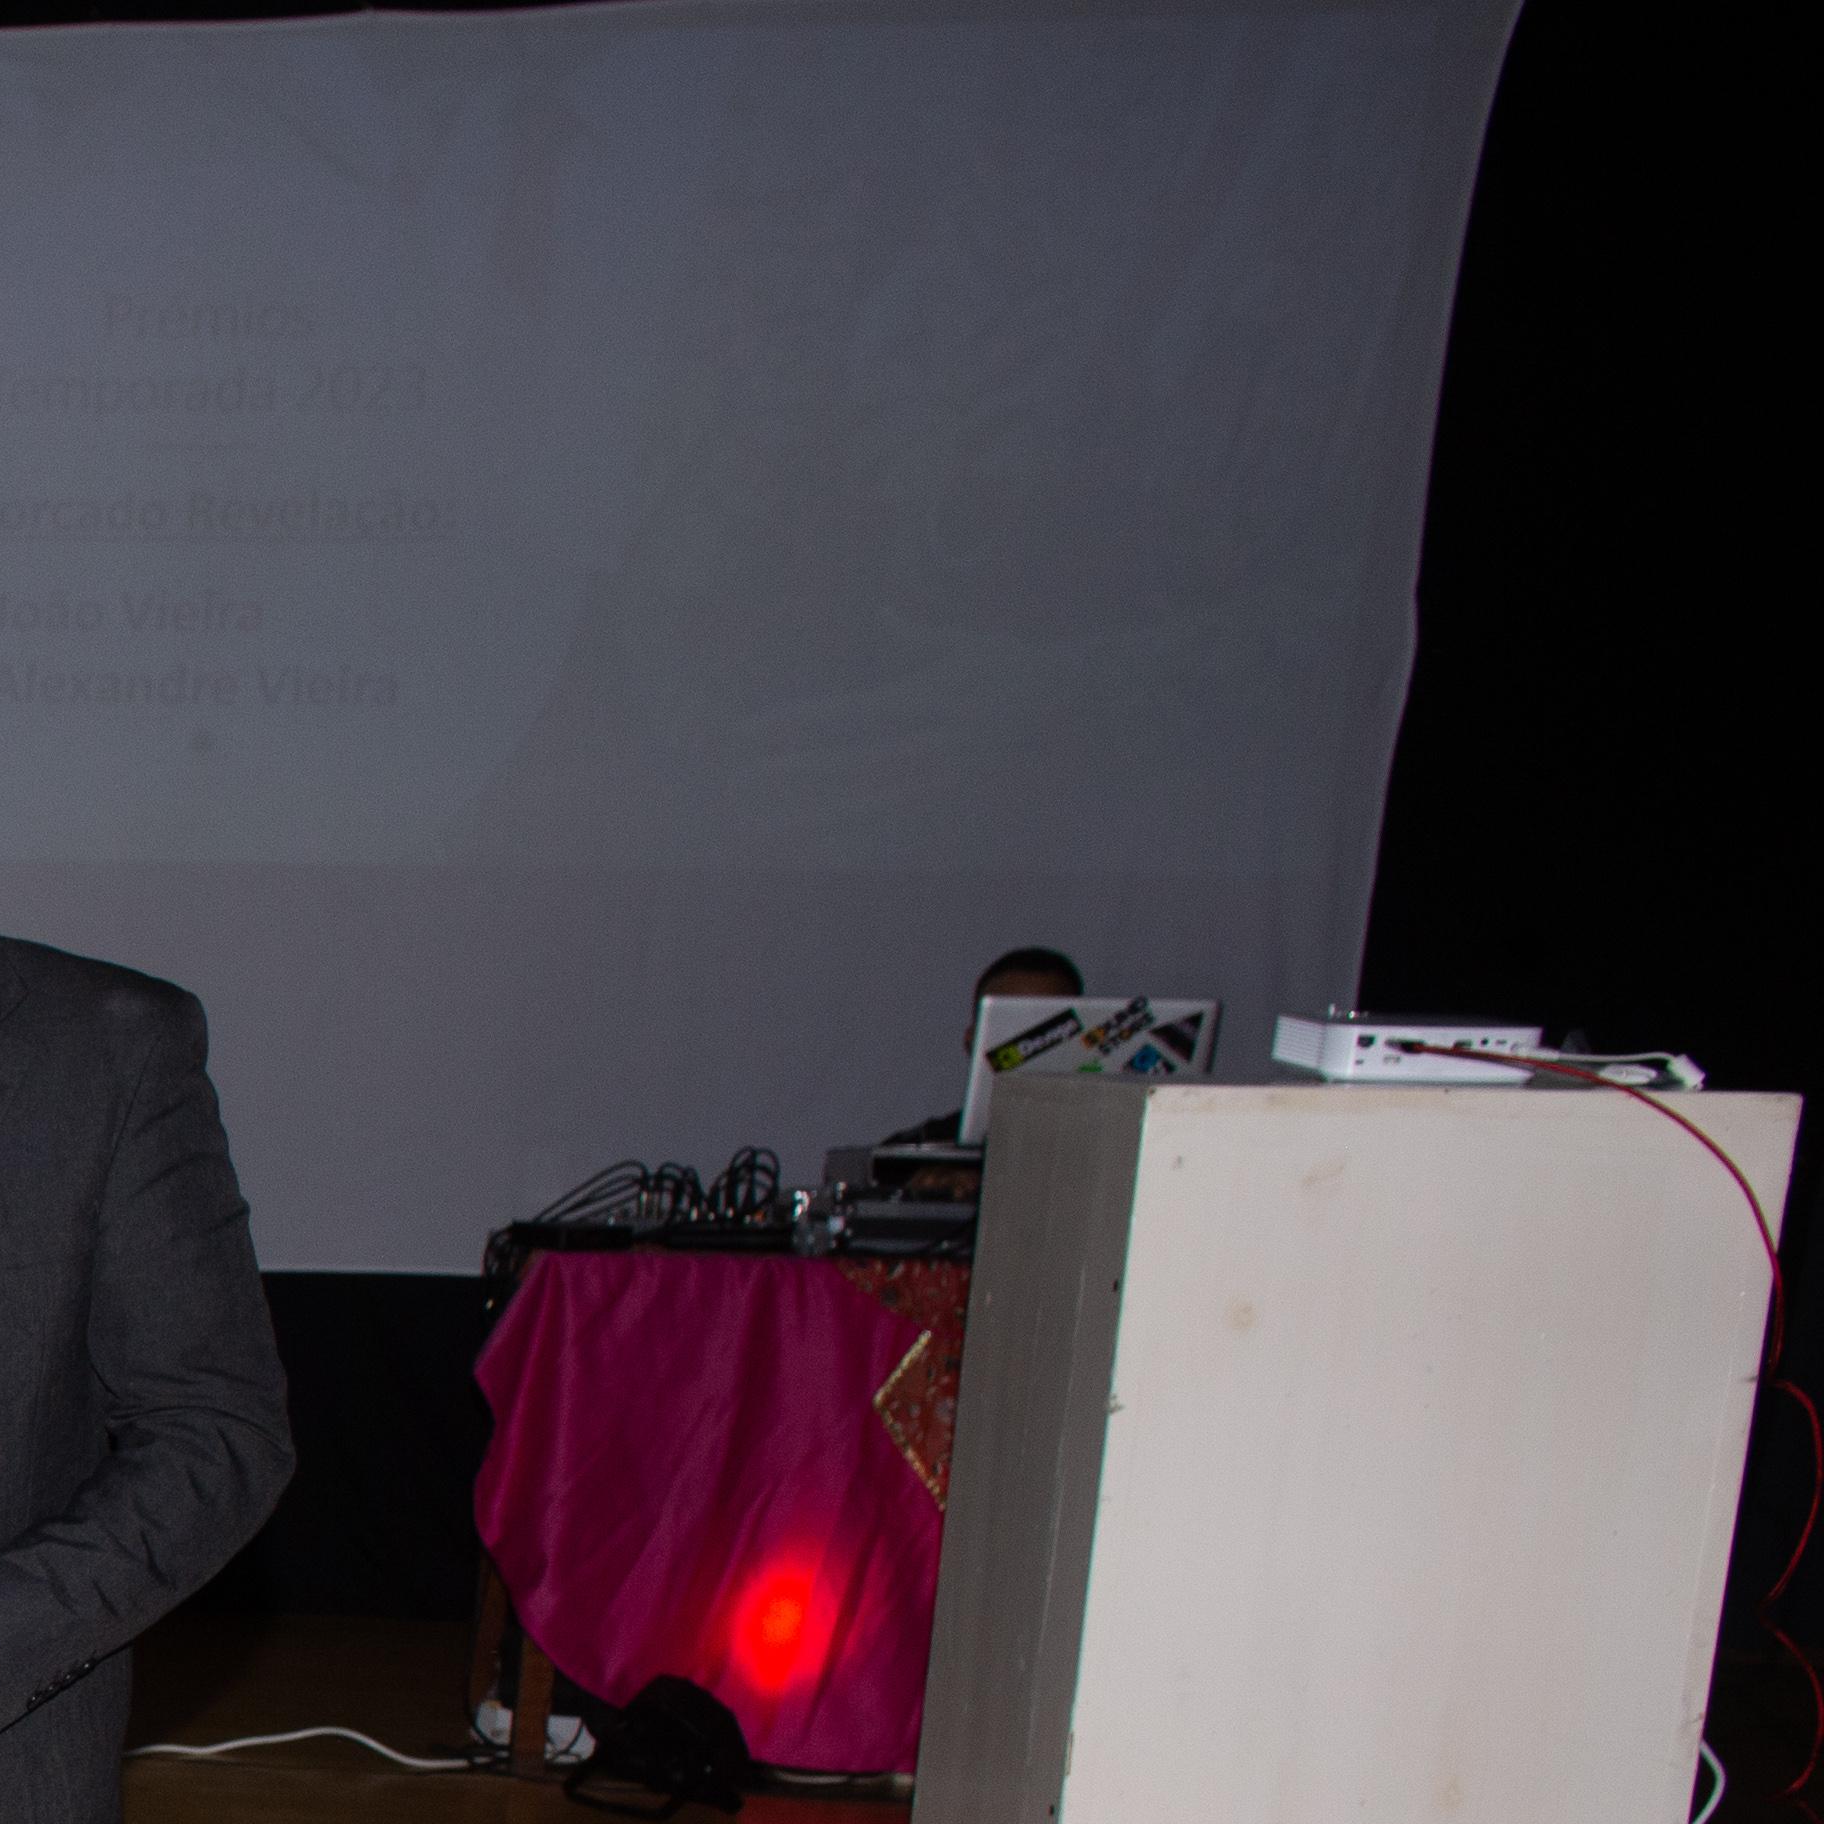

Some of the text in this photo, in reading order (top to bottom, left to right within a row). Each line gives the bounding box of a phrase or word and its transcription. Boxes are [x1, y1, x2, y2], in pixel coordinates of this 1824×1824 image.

[295, 364, 427, 412] 2023
[123, 588, 264, 632] Vieira
[257, 664, 400, 706] Vieira
